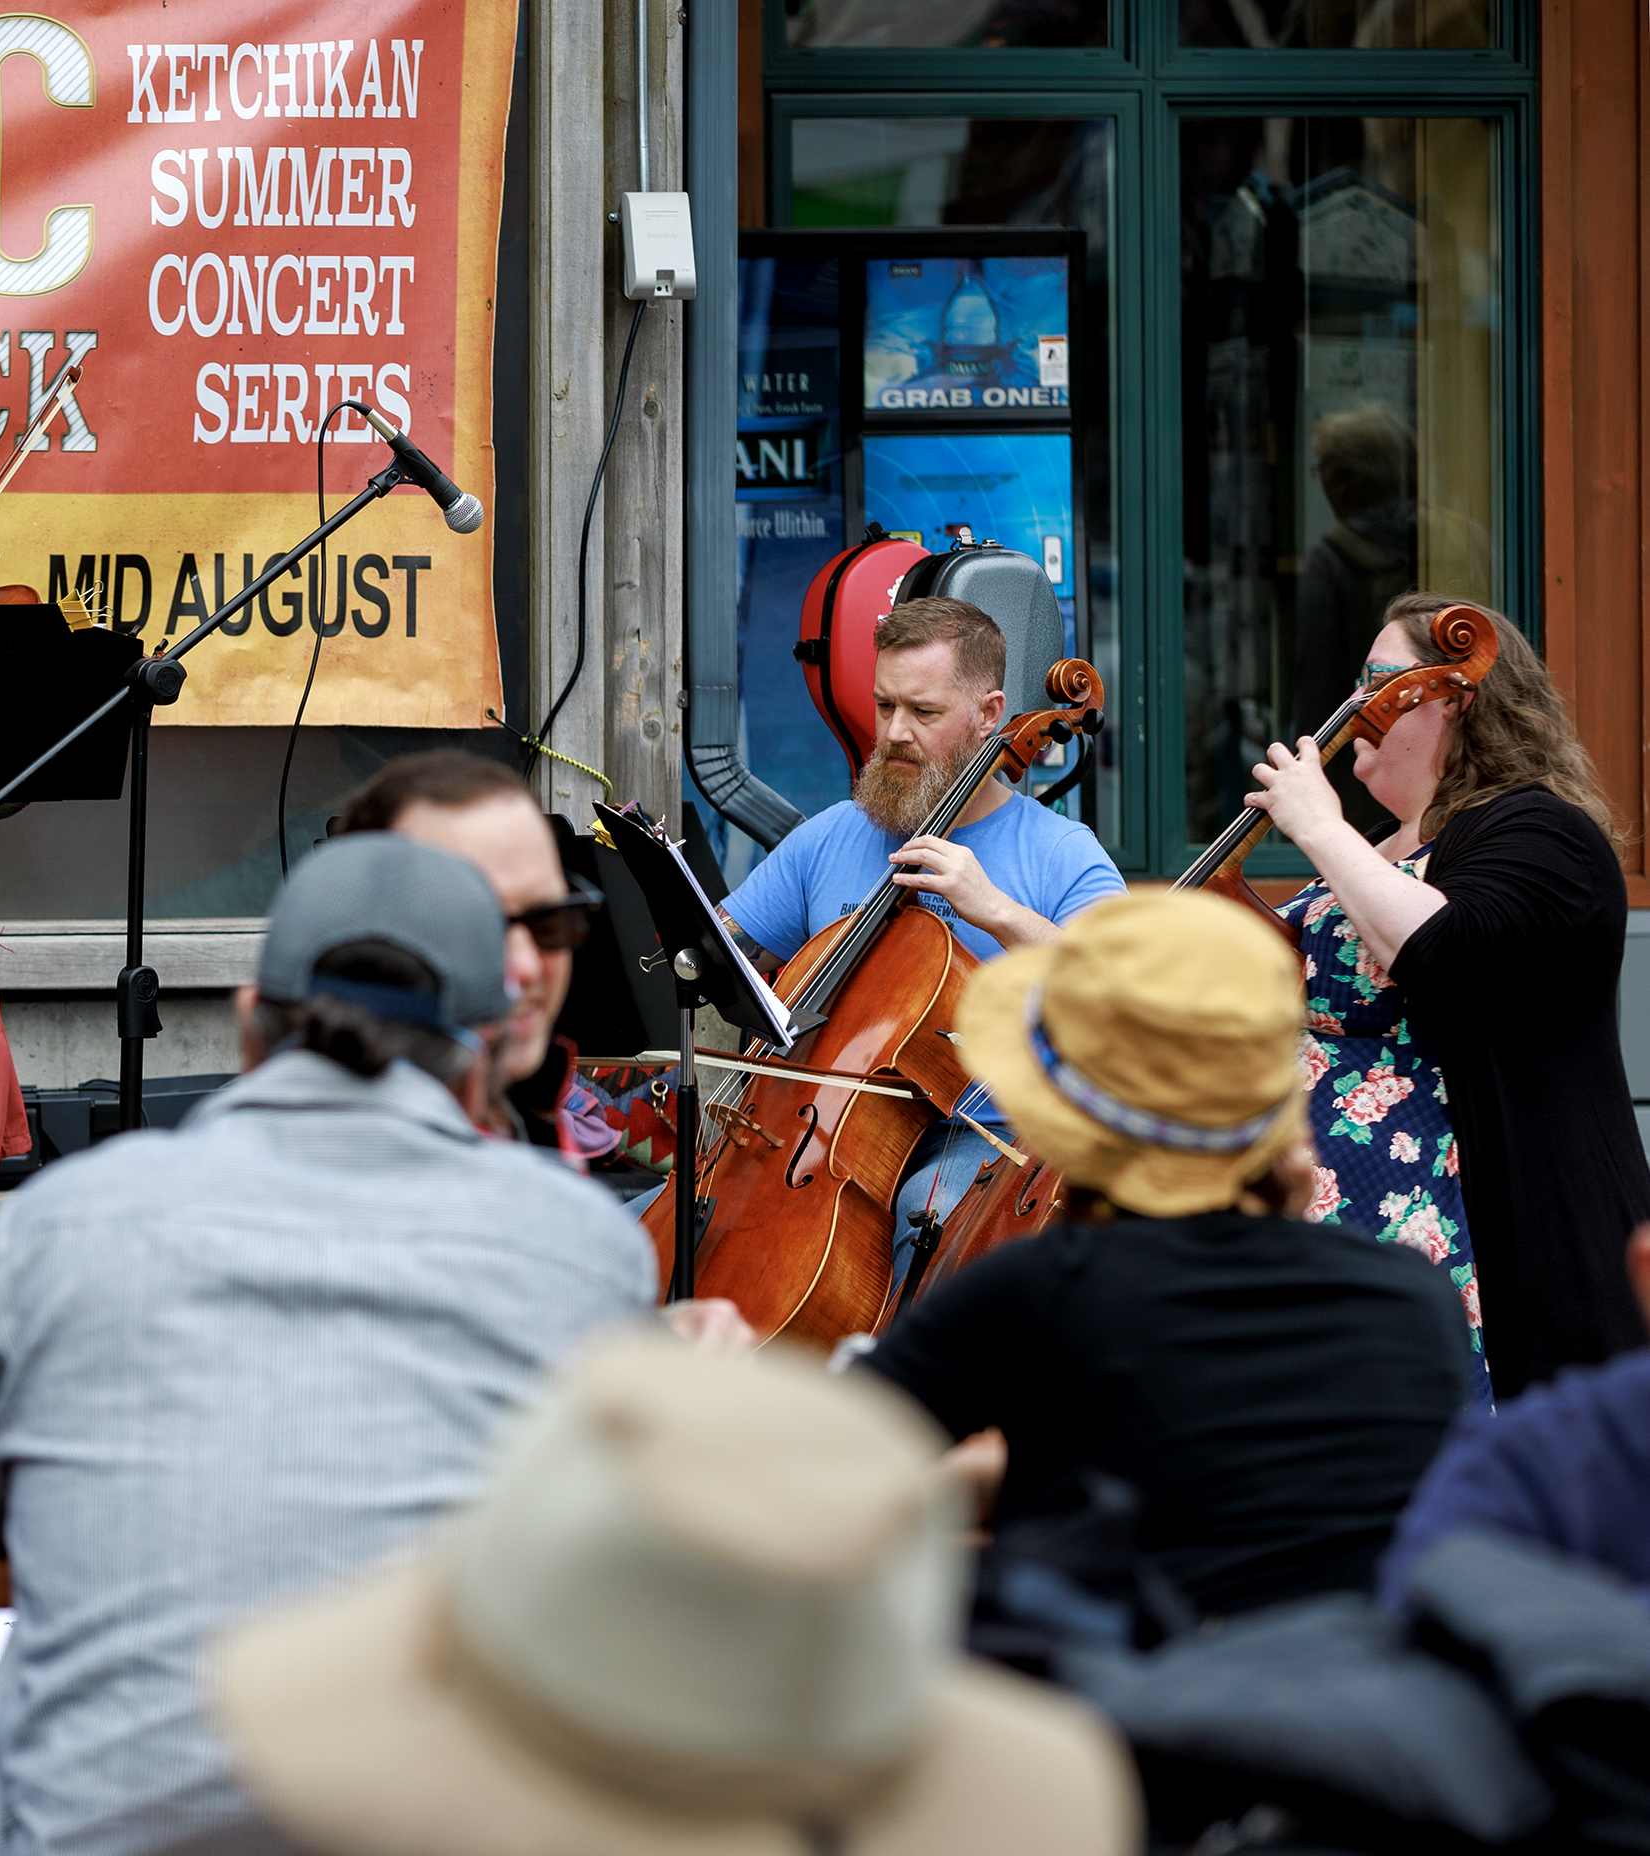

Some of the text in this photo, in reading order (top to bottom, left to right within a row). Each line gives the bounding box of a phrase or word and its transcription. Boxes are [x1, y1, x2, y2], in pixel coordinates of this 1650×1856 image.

[126, 38, 425, 124] KETCHIKAN
[150, 146, 417, 229] SUMMER
[148, 252, 416, 338] CONCERT
[193, 362, 412, 445] SERIES
[742, 371, 810, 395] WATER
[880, 386, 1060, 409] GRAB ONE!
[49, 553, 153, 633] MID
[164, 553, 432, 639] AUGUST
